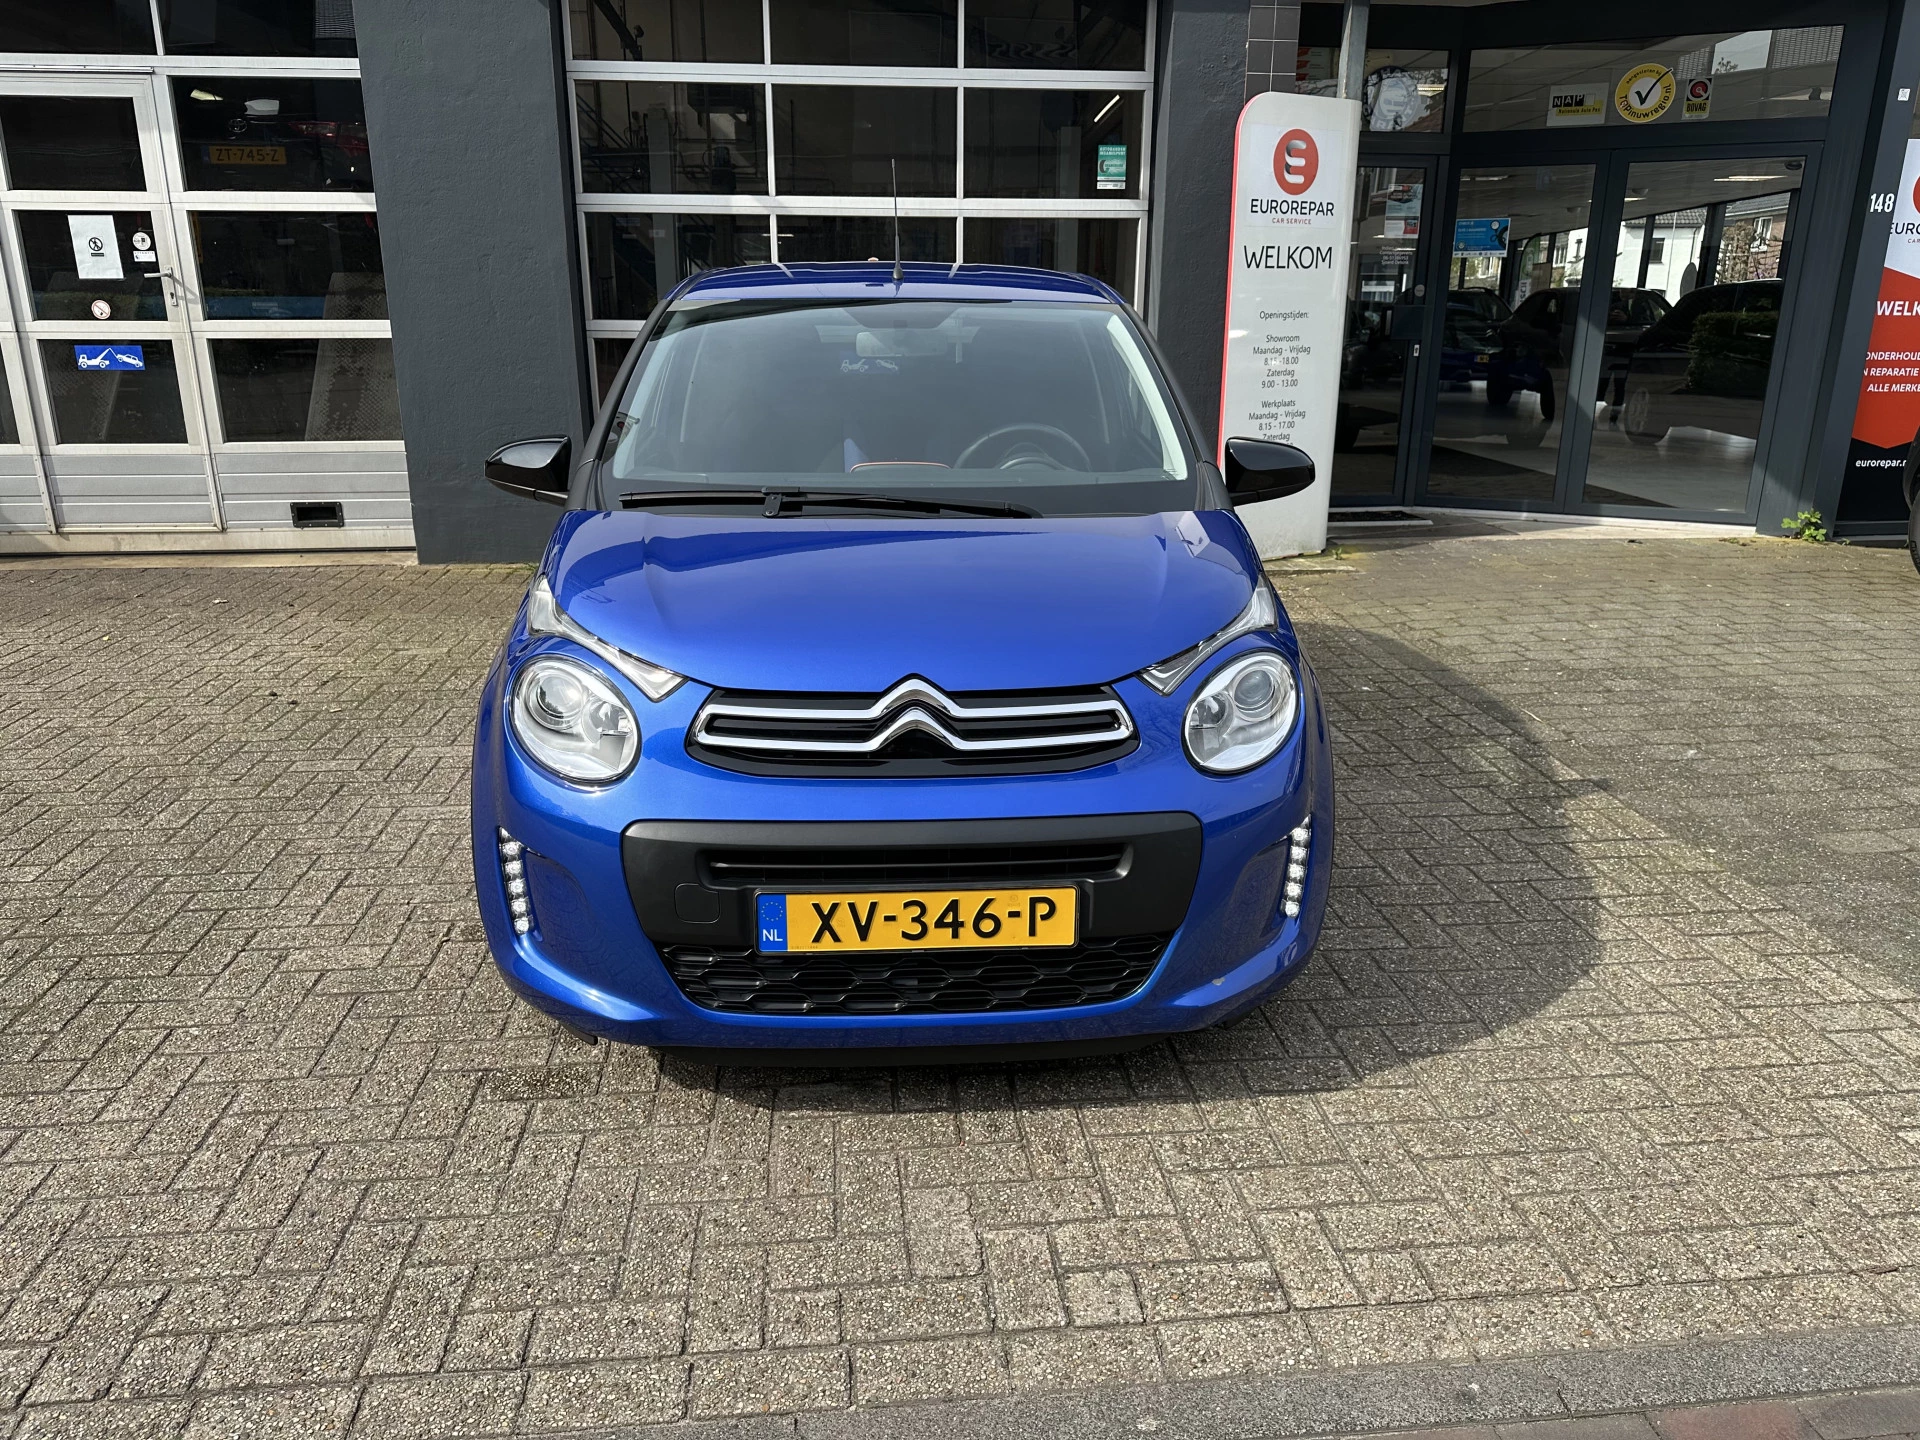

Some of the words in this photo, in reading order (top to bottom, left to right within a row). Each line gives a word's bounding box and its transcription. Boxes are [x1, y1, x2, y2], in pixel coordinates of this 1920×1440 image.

[1553, 93, 1584, 107] NAP
[1686, 102, 1707, 112] BOVAG
[216, 148, 280, 161] ZT-745-Z
[1250, 198, 1335, 217] EUROREPAR
[1869, 193, 1895, 212] 148
[1243, 245, 1333, 270] WELKOM
[1259, 310, 1309, 321] Openingstijden:
[1266, 335, 1300, 343] Showroom
[1252, 346, 1283, 356] Maandag
[1289, 345, 1311, 355] Vrijdag
[1266, 368, 1295, 378] Zaterdag
[1870, 367, 1920, 377] REPARATIE
[1261, 380, 1276, 388] 9.00
[1281, 378, 1299, 387] 13.00
[1867, 383, 1890, 392] ALLE
[1261, 399, 1296, 409] Werkplaats
[1248, 411, 1279, 421] Maandag
[1284, 410, 1306, 420] Vrijdag
[1258, 422, 1272, 431] 8.15
[1278, 420, 1296, 430] 17.00
[762, 929, 783, 942] NL
[810, 895, 1057, 943] XV-346-P
